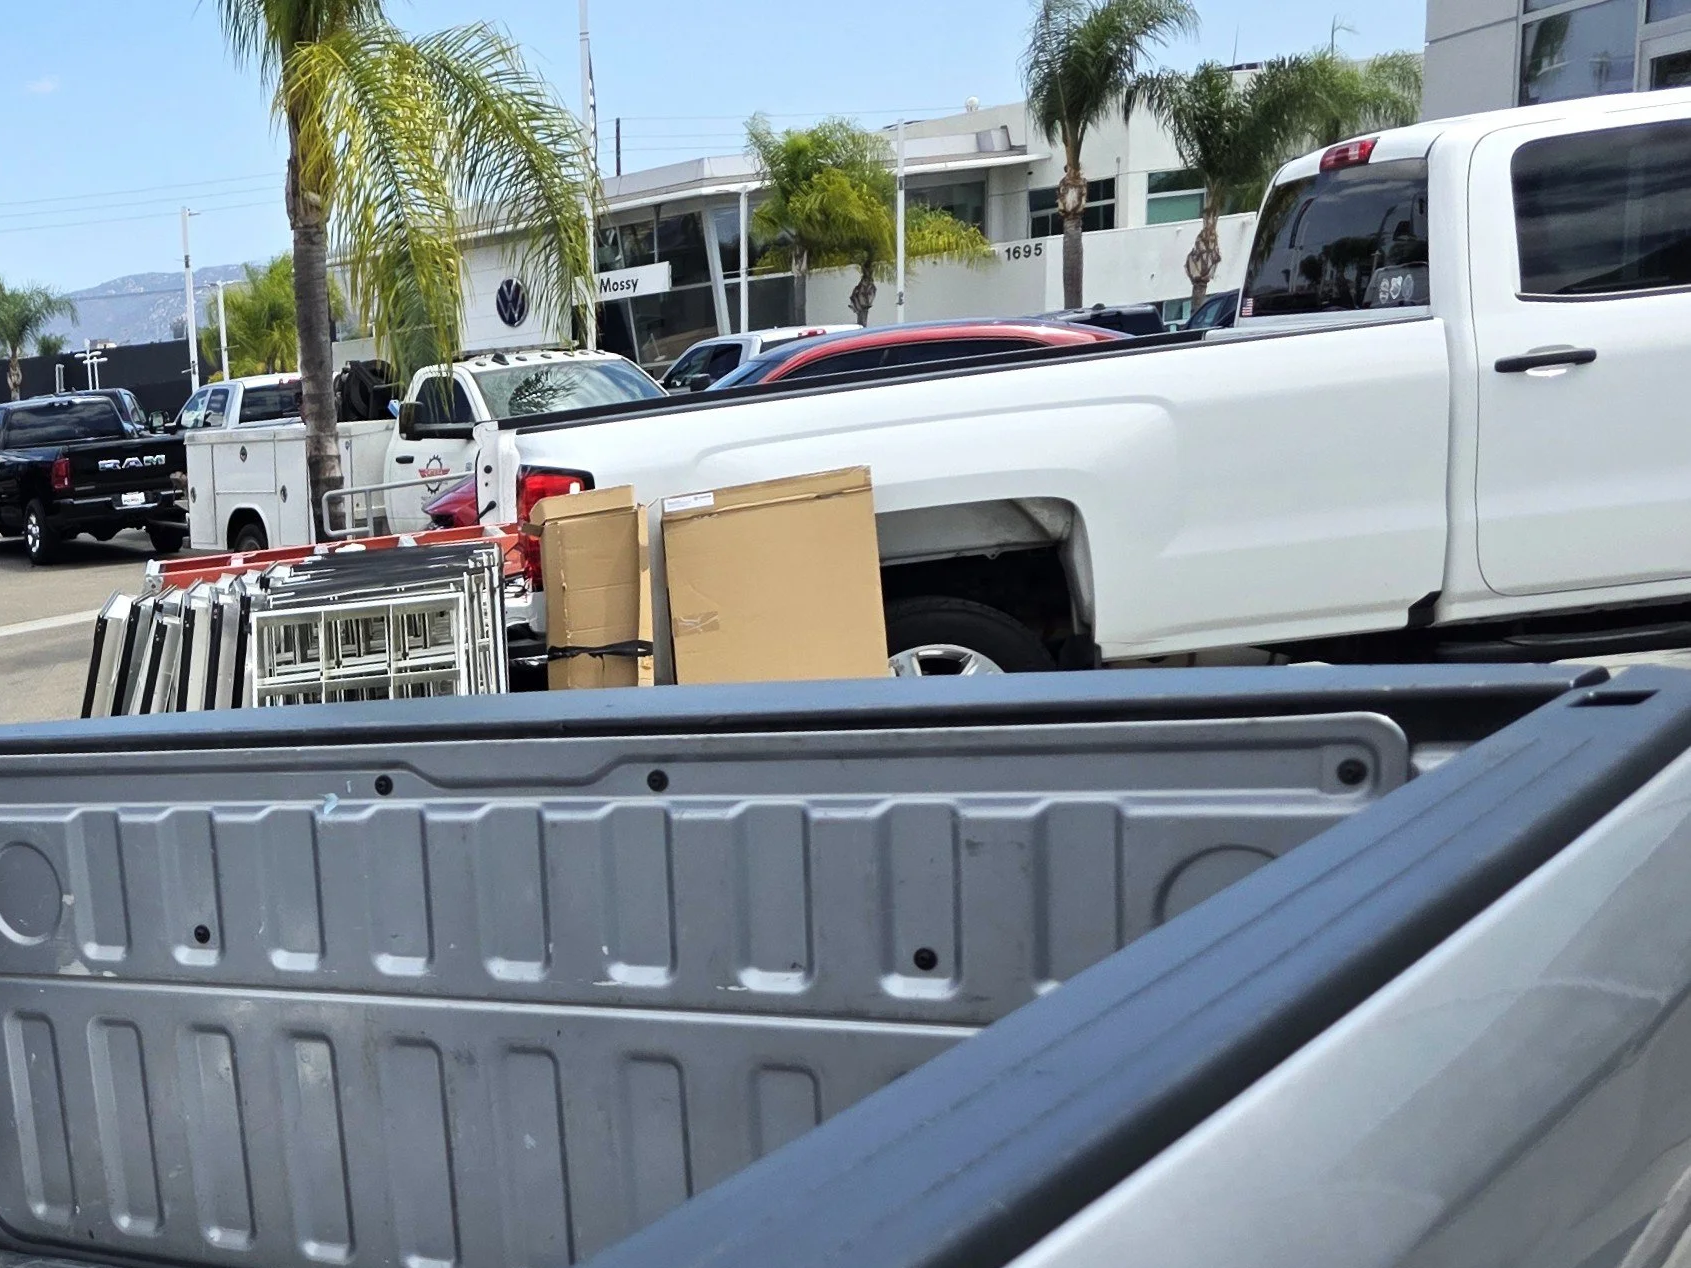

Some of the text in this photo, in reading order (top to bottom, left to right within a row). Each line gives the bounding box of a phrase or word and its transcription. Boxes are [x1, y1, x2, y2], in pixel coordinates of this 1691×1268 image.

[1005, 242, 1043, 261] 1695
[599, 278, 640, 294] Mossy
[97, 454, 166, 471] RAM
